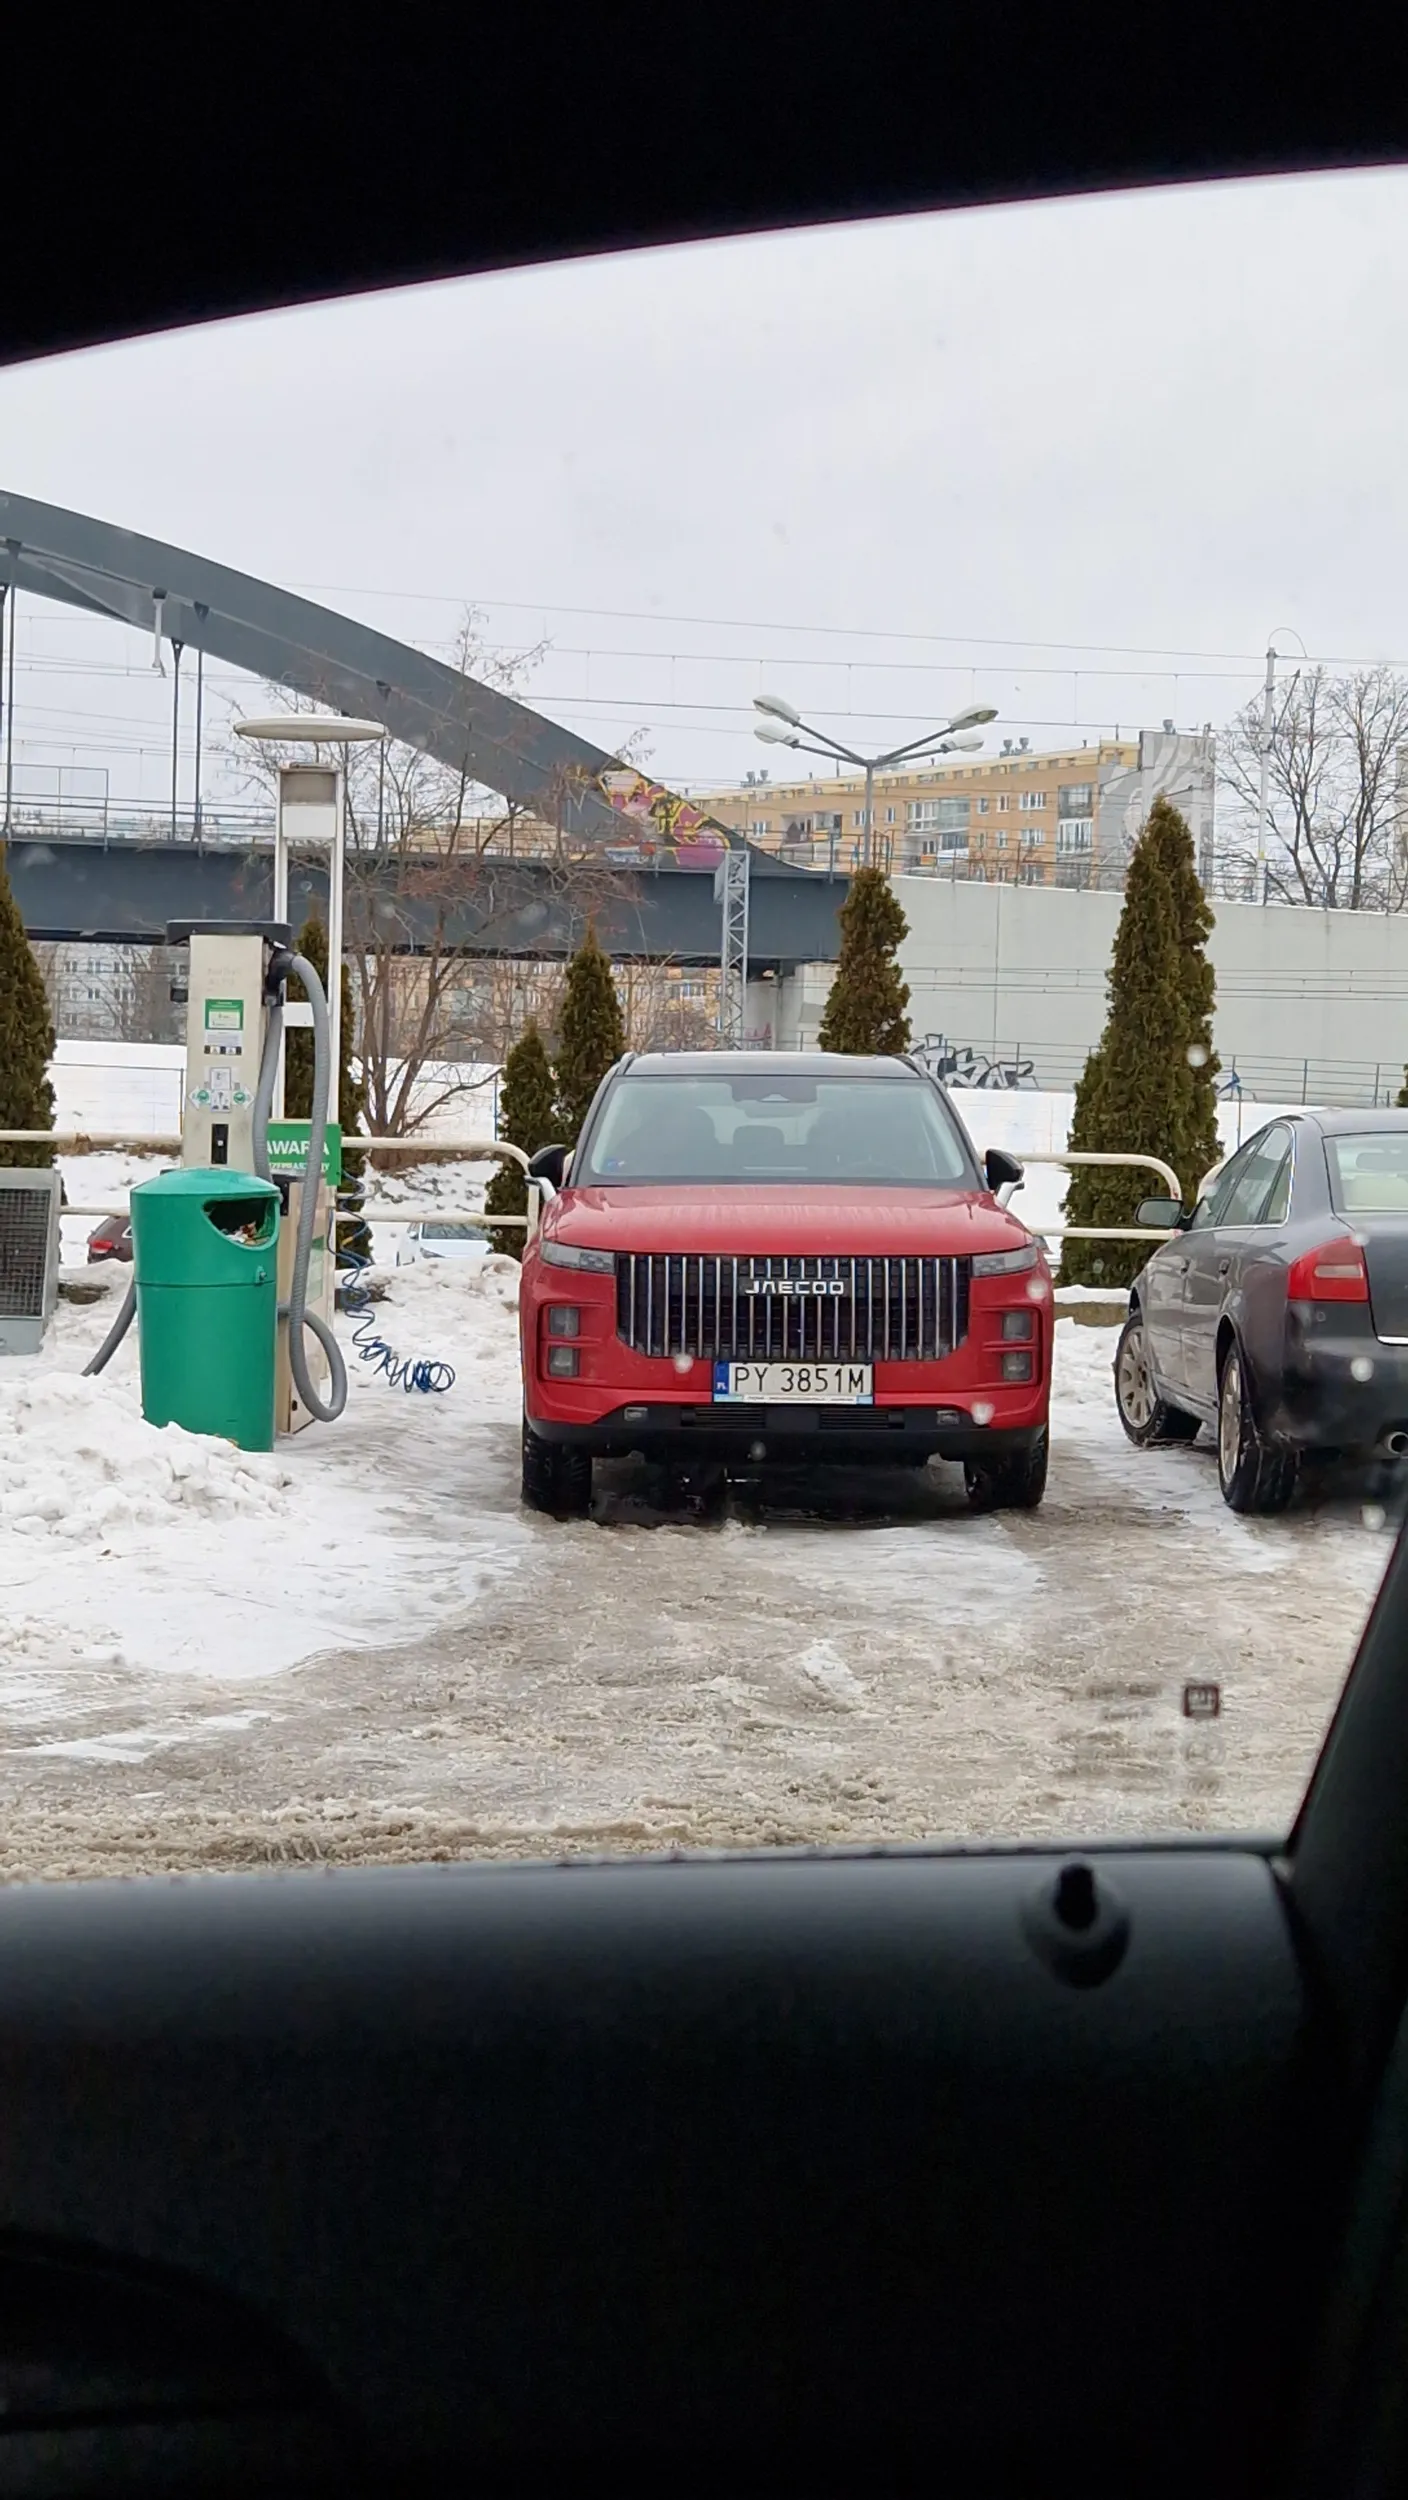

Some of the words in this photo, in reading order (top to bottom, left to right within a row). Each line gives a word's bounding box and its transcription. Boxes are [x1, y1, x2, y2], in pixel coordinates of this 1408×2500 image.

[744, 1281, 844, 1295] JAECOO
[734, 1366, 769, 1392] PY
[781, 1367, 864, 1393] 3851M
